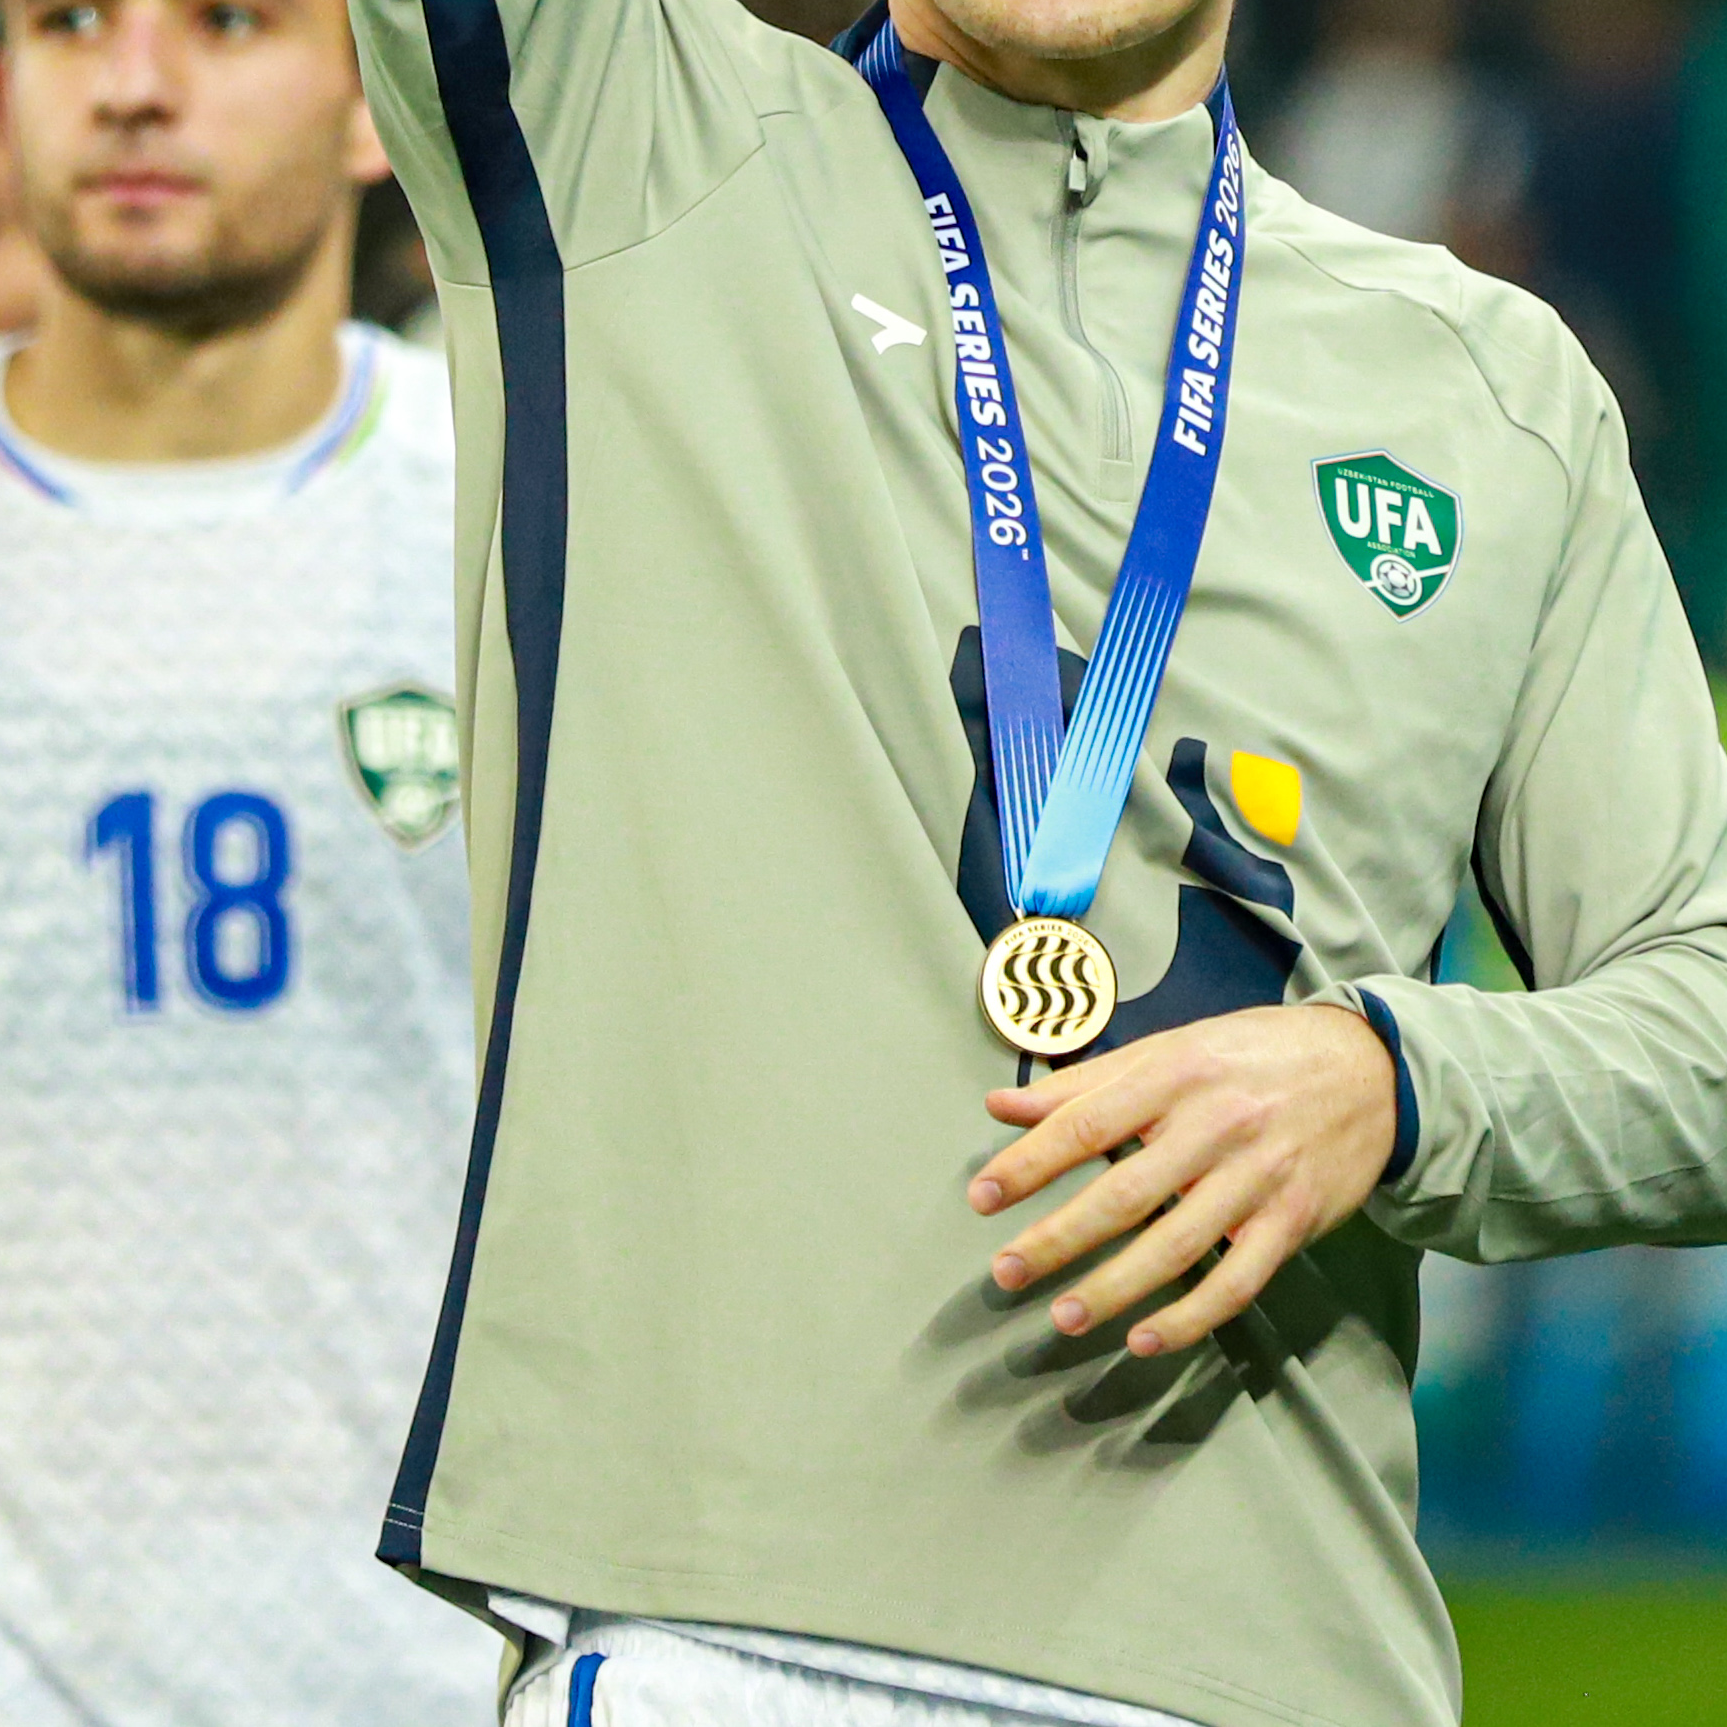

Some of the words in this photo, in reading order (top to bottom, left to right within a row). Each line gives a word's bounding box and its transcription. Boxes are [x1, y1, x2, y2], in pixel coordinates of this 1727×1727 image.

[924, 192, 970, 274] FIFA
[947, 282, 1007, 426] SERIES
[1188, 228, 1234, 369] SERIES
[1174, 368, 1217, 456] FIFA
[1335, 477, 1443, 556] UFA
[1336, 467, 1389, 487] UZBEKISTAN
[1390, 480, 1435, 499] FOOTBALL
[1367, 541, 1416, 559] ASSOCIATION
[84, 788, 292, 1016] 18
